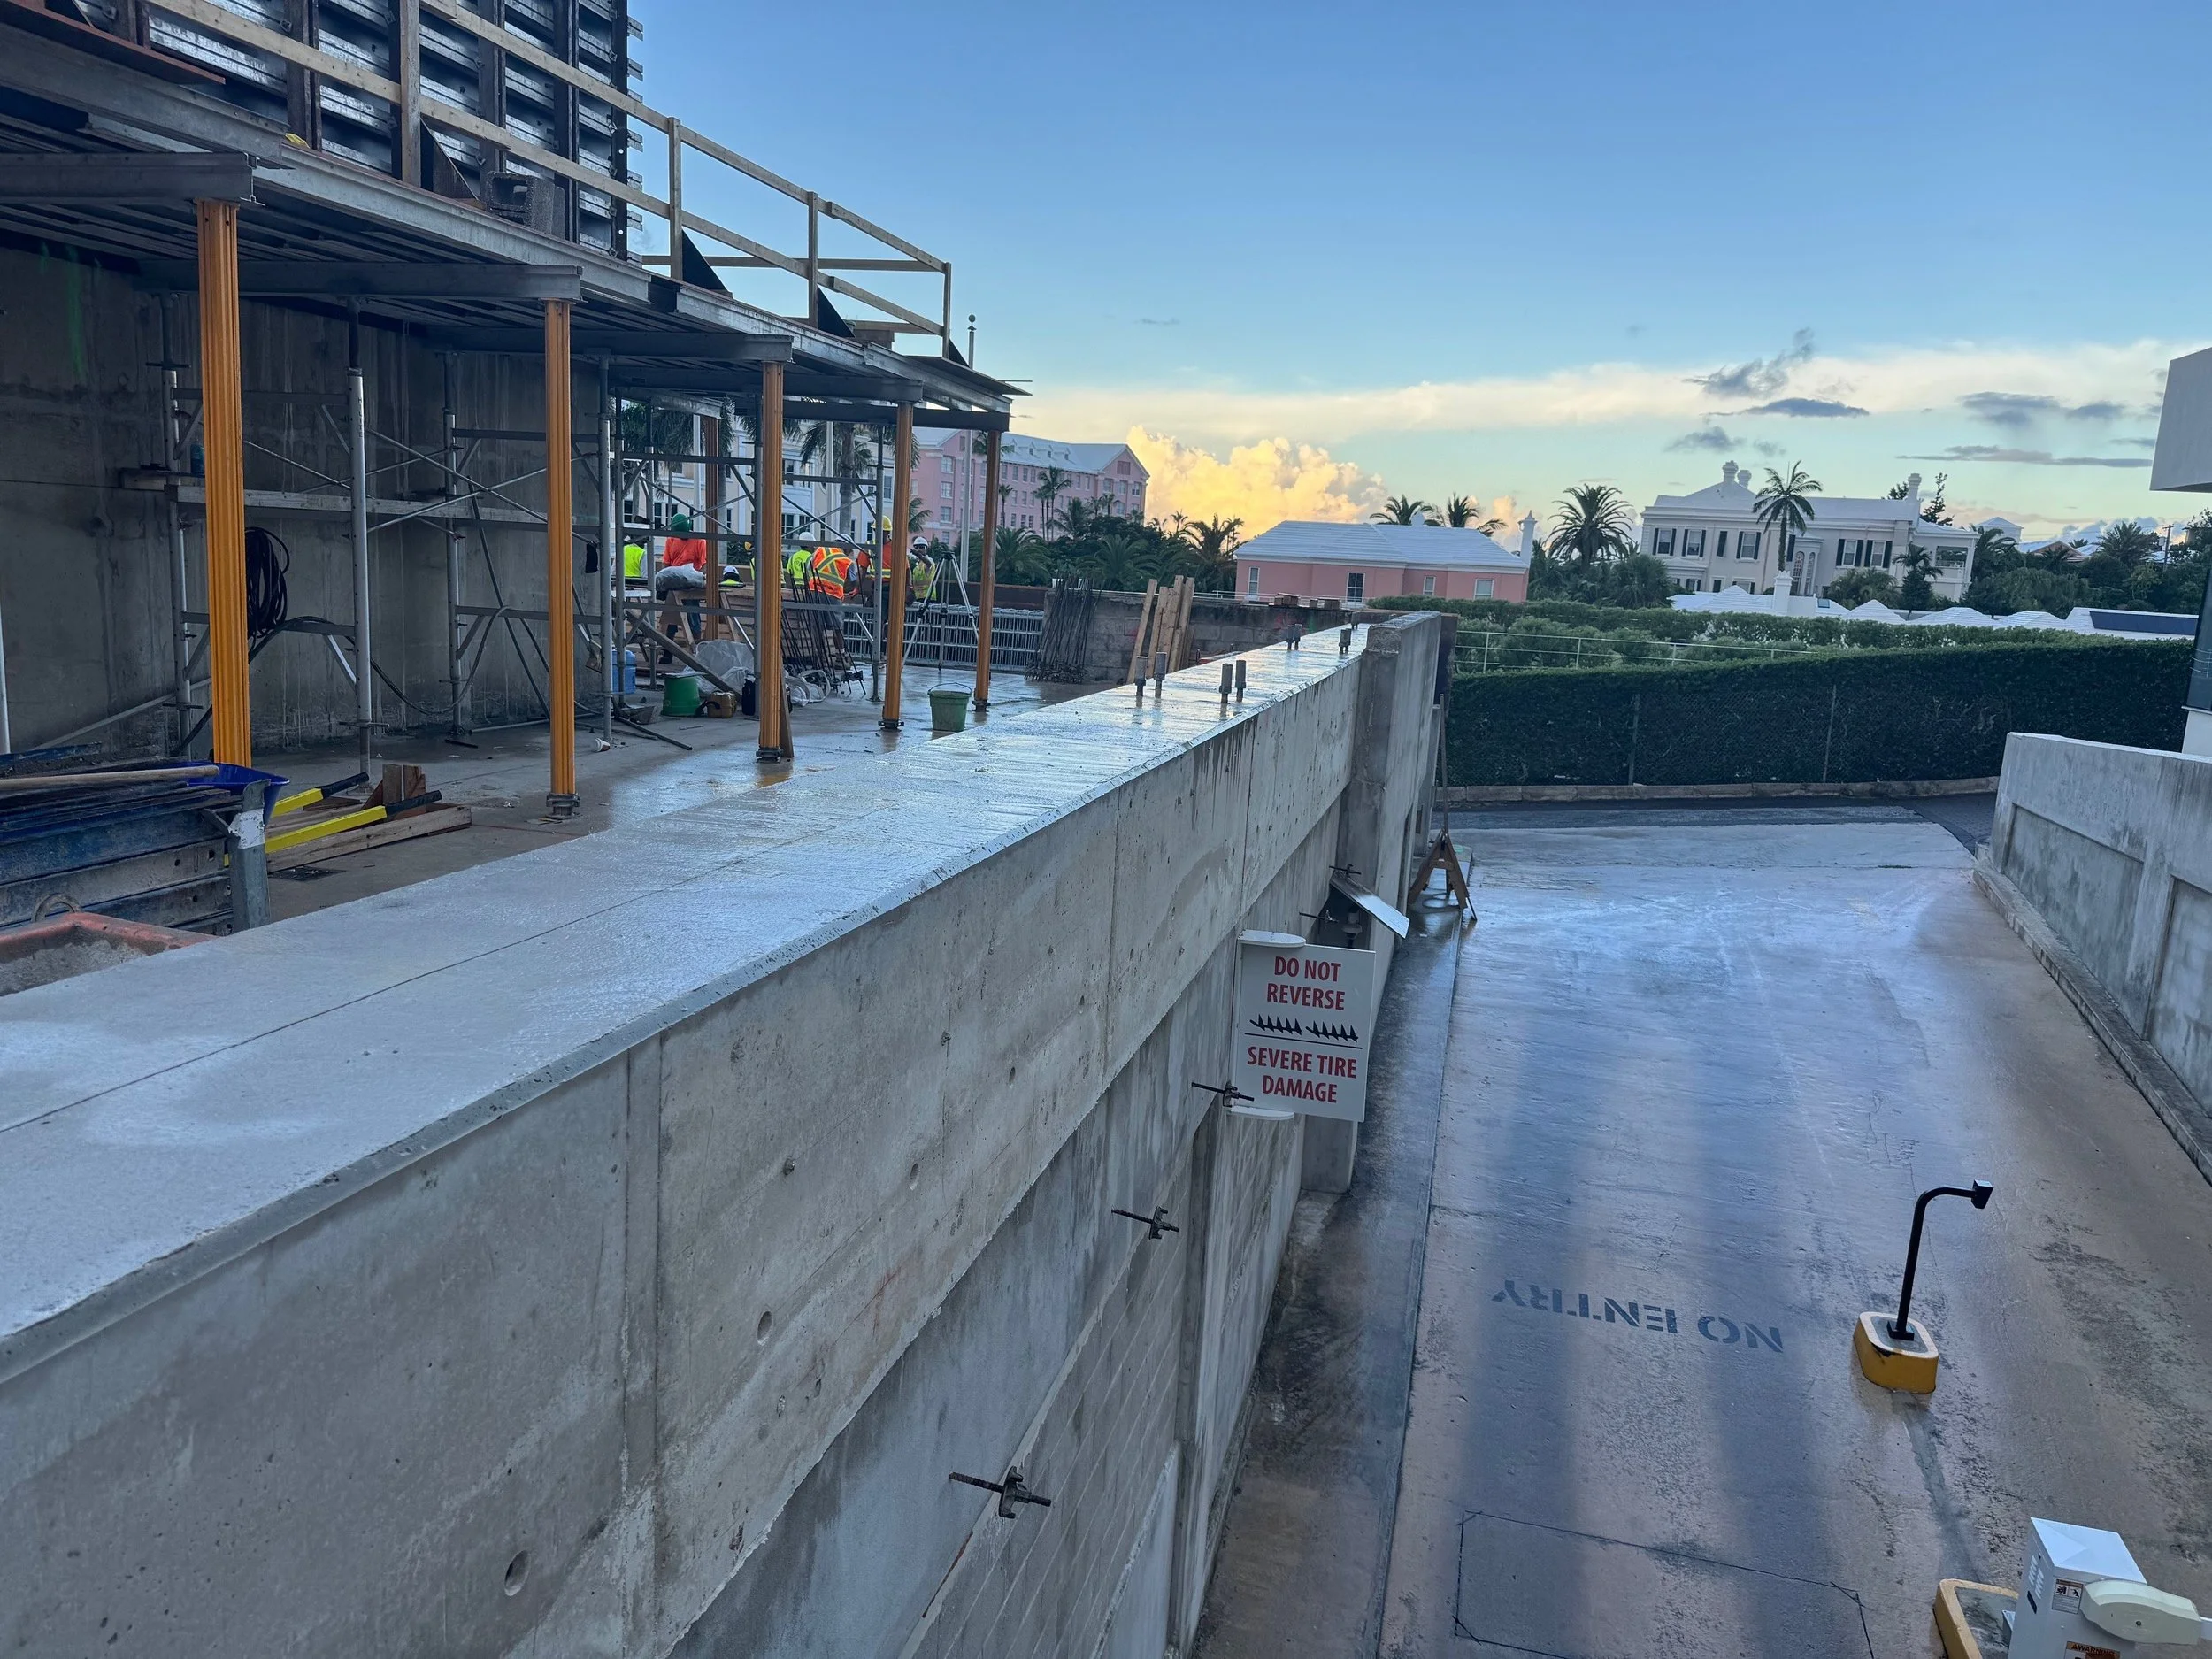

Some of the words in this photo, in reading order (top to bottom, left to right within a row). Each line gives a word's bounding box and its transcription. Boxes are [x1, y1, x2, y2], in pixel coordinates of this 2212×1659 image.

[1274, 956, 1300, 978] DO
[1304, 959, 1341, 982] NOT
[1267, 983, 1346, 1010] REVERSE
[1248, 1046, 1313, 1072] SEVERE
[1317, 1055, 1357, 1079] TIRE
[1263, 1075, 1338, 1103] DAMAGE
[1491, 1279, 1678, 1334] ENTRY
[1697, 1316, 1784, 1354] NO
